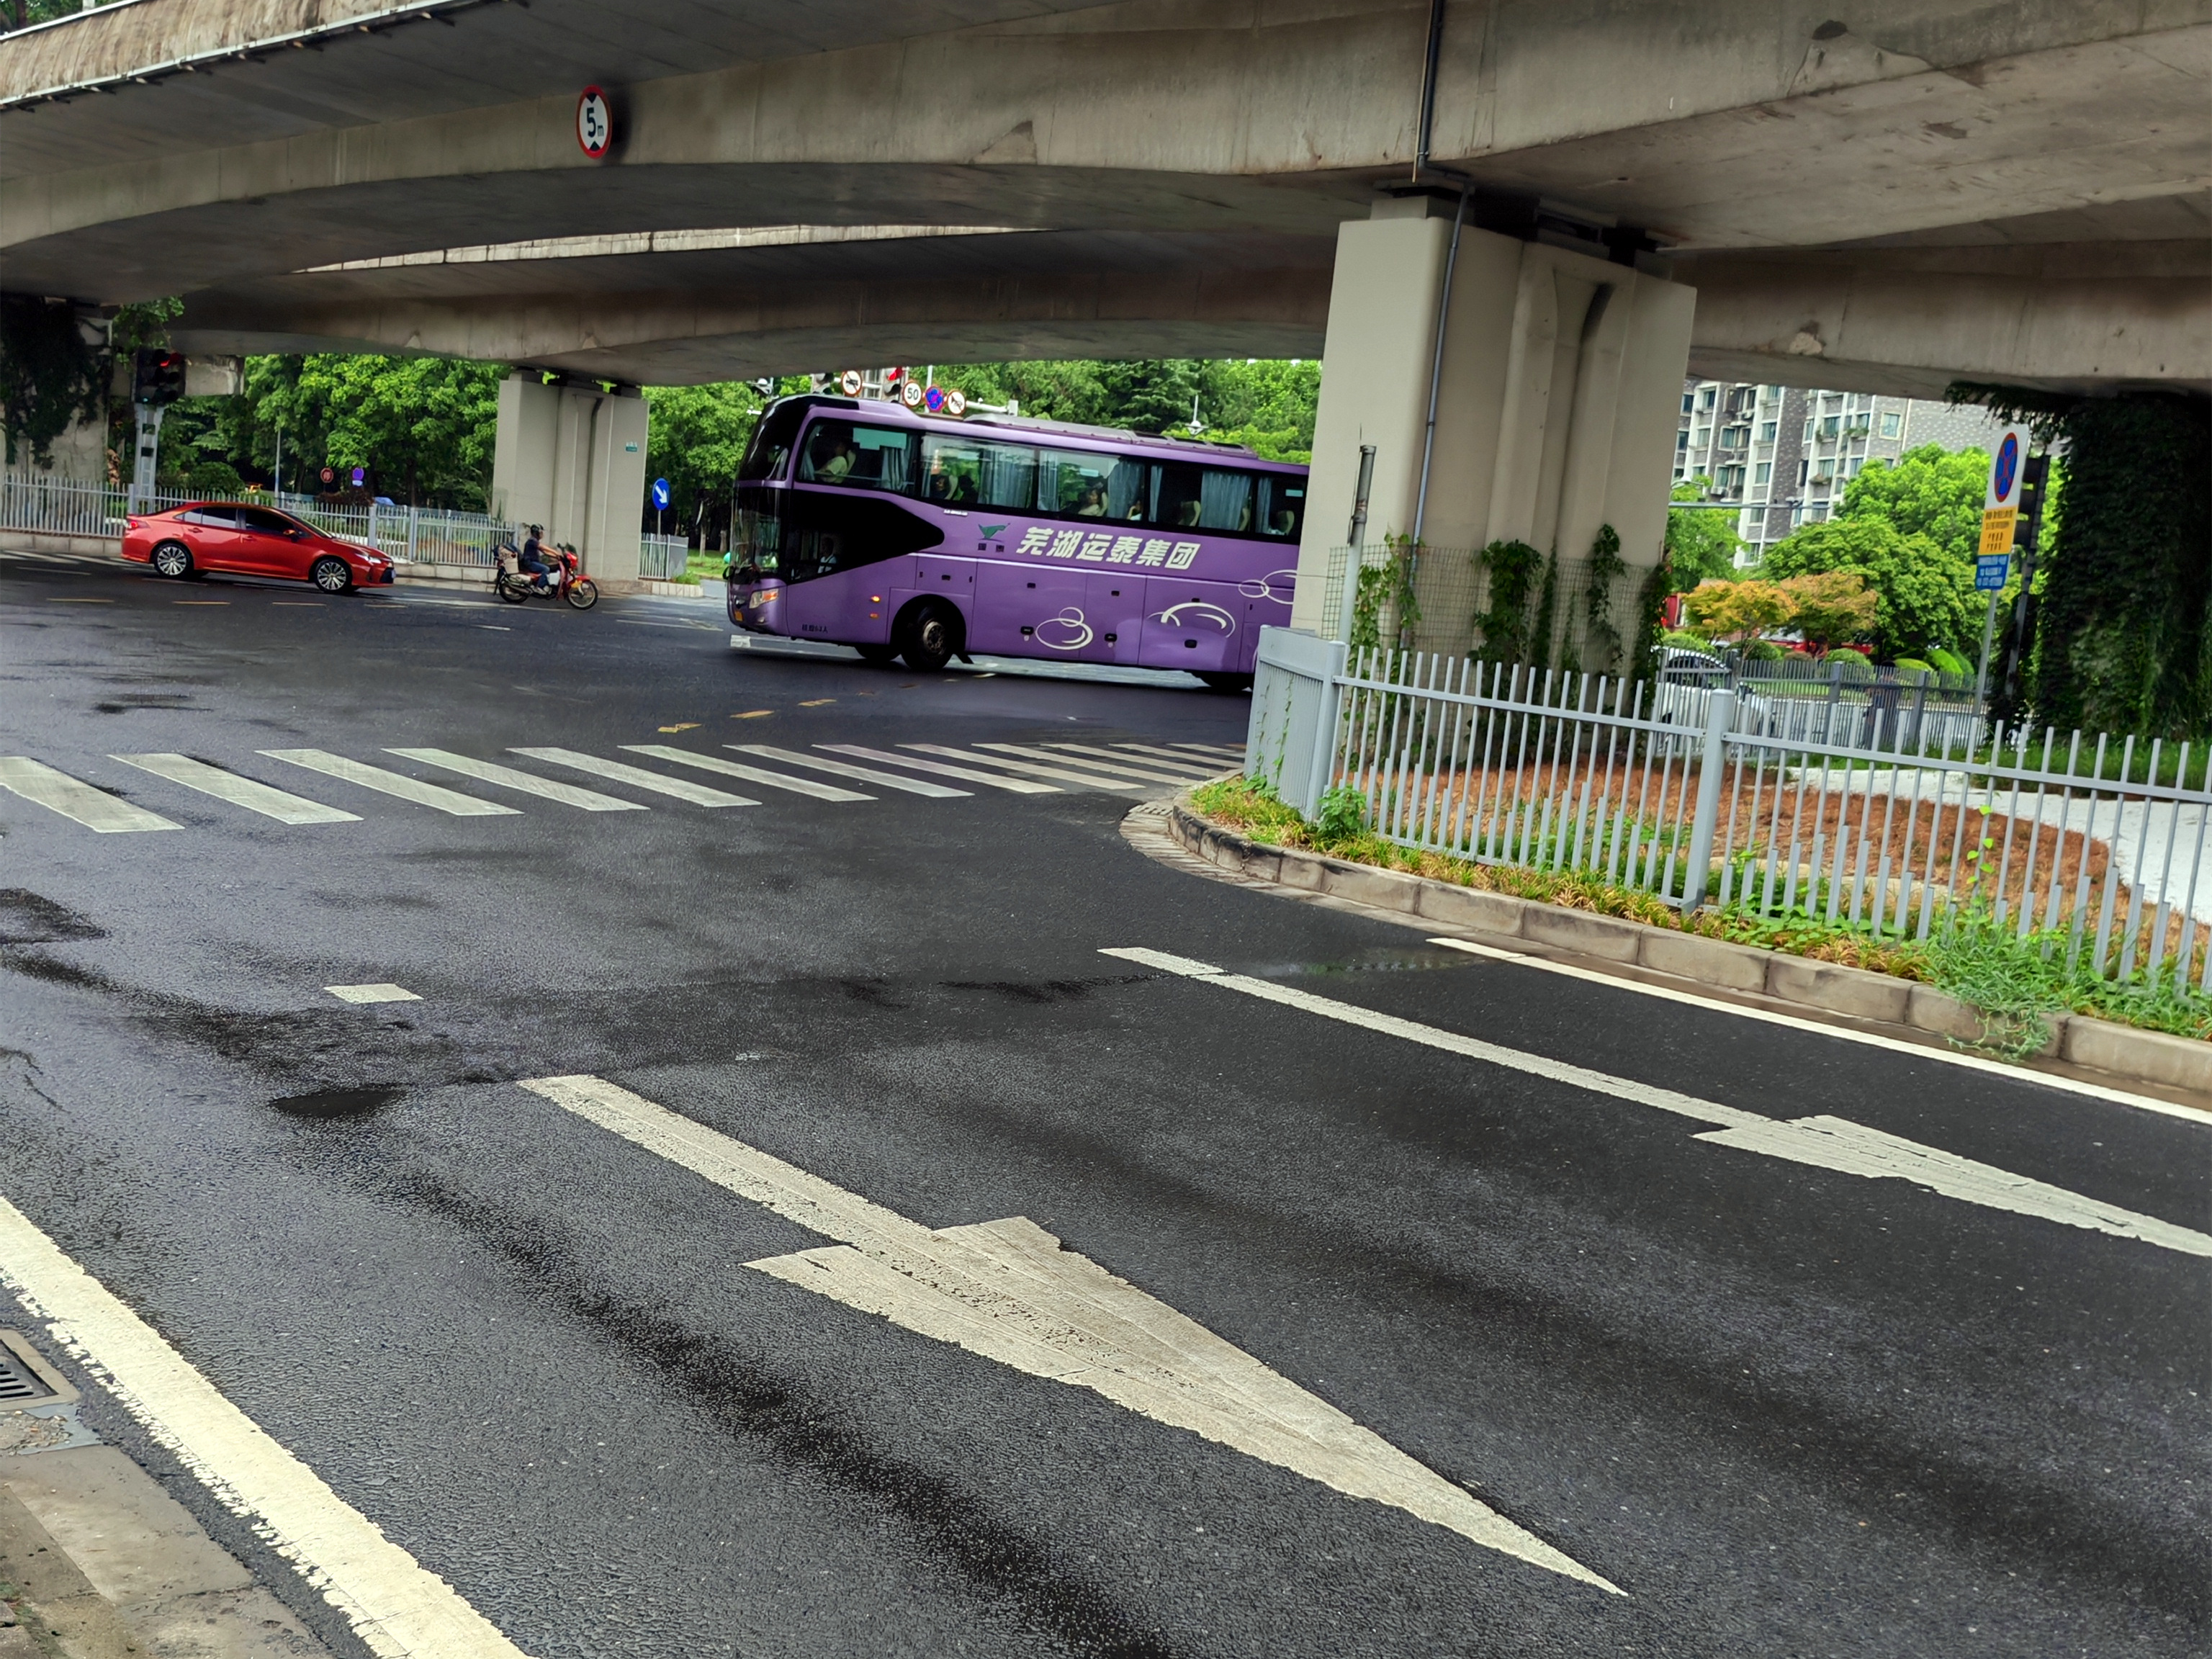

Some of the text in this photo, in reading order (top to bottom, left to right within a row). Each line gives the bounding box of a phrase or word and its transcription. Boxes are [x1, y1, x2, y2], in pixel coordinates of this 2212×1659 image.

[586, 107, 604, 138] 5m
[907, 387, 919, 400] 50
[1016, 527, 1201, 570] 芜湖运泰集团
